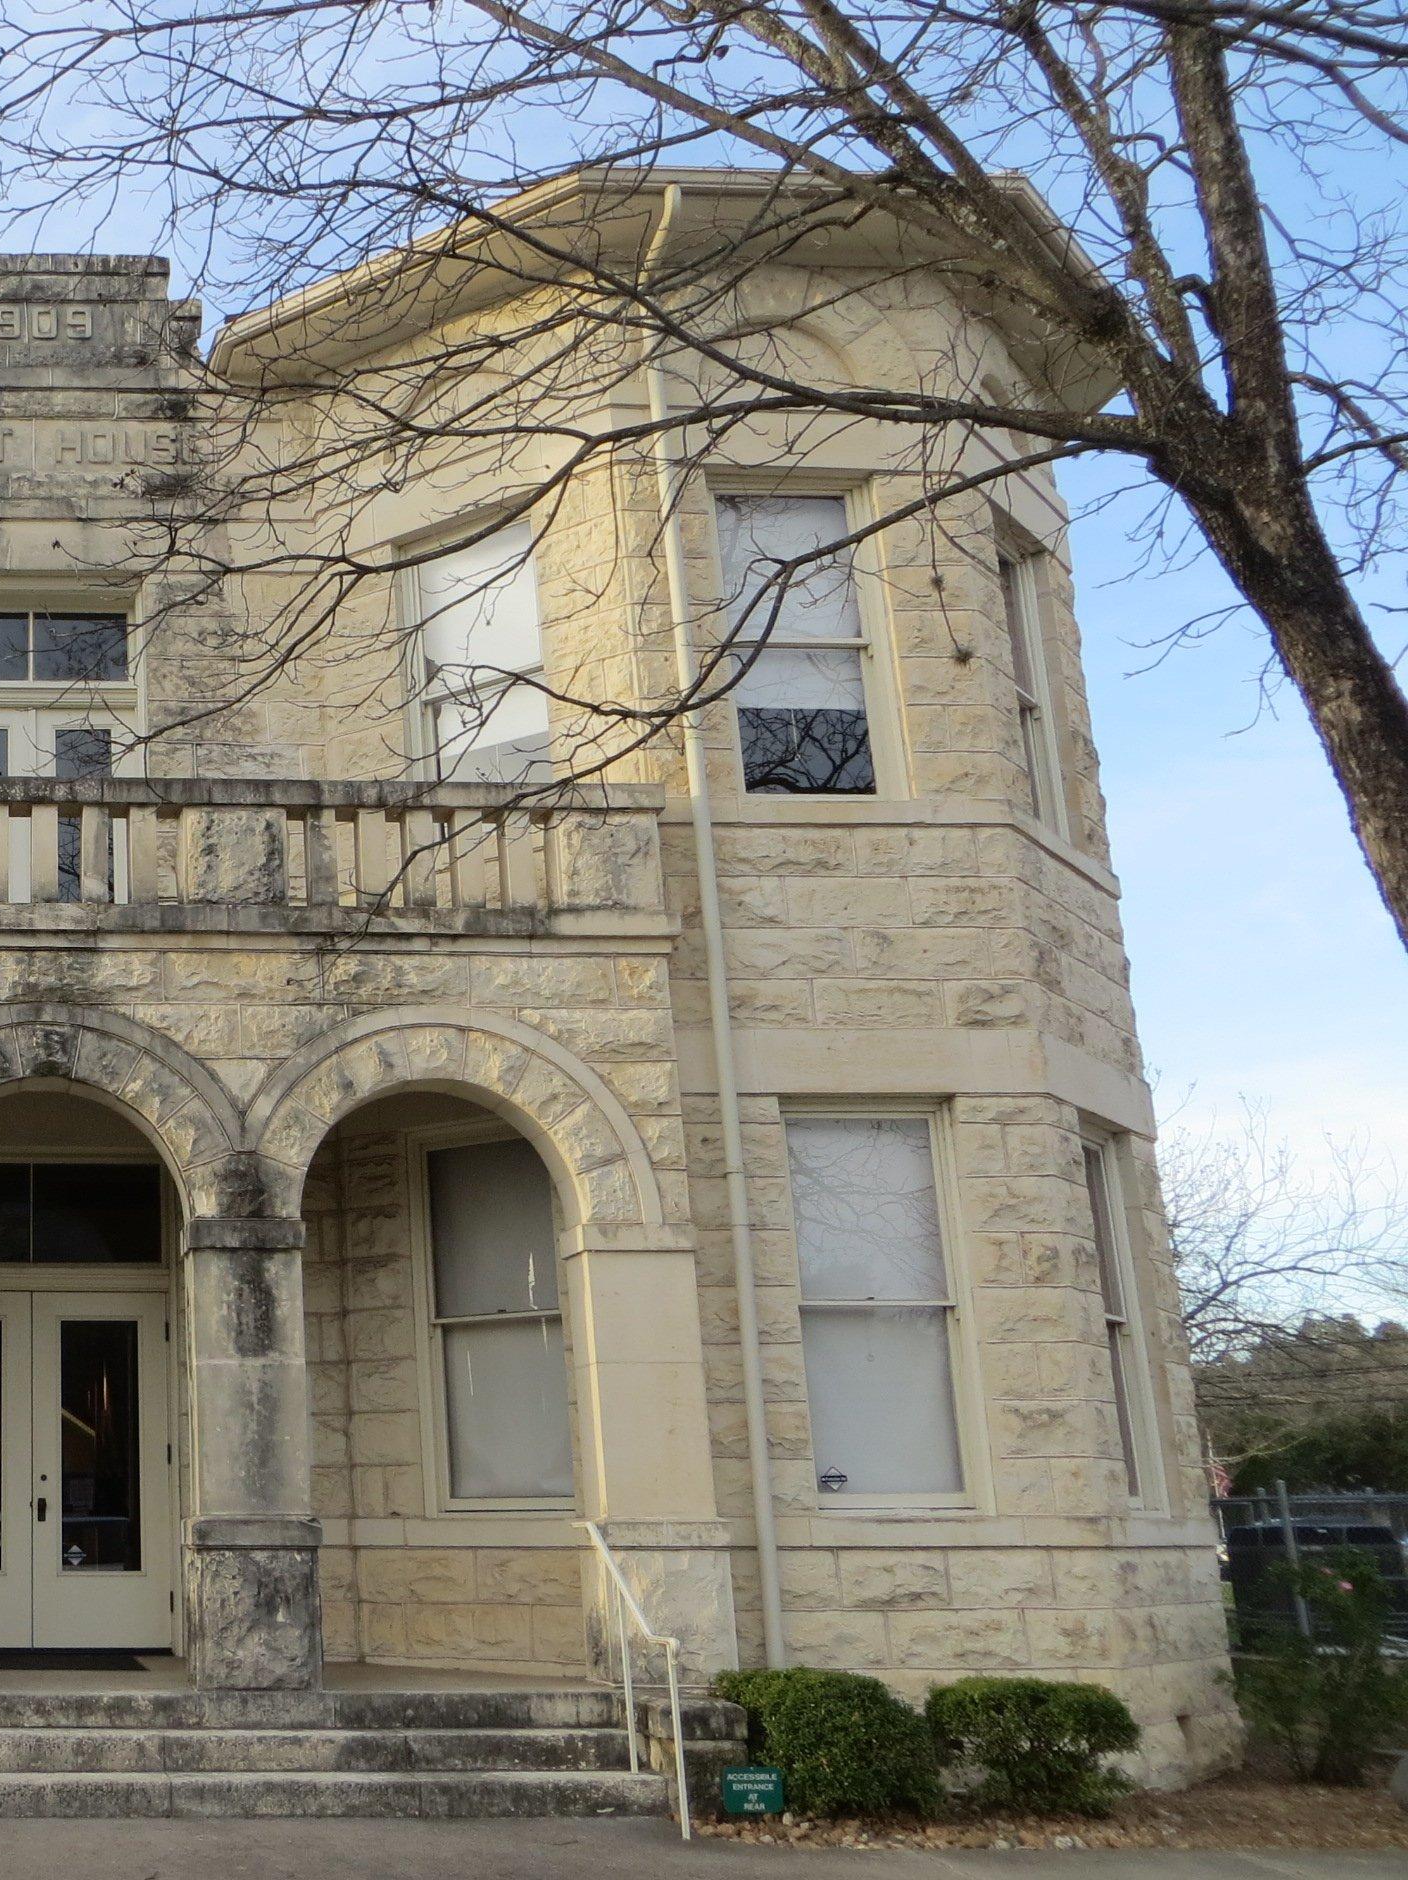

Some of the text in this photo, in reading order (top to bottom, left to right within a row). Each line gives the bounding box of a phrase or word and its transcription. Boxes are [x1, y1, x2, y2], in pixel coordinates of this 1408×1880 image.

[55, 428, 209, 465] HOUSE
[727, 1773, 778, 1781] ACCESSIBLE
[732, 1783, 774, 1791] ENTRANCE
[747, 1793, 759, 1801] AT
[744, 1802, 766, 1811] REAR
